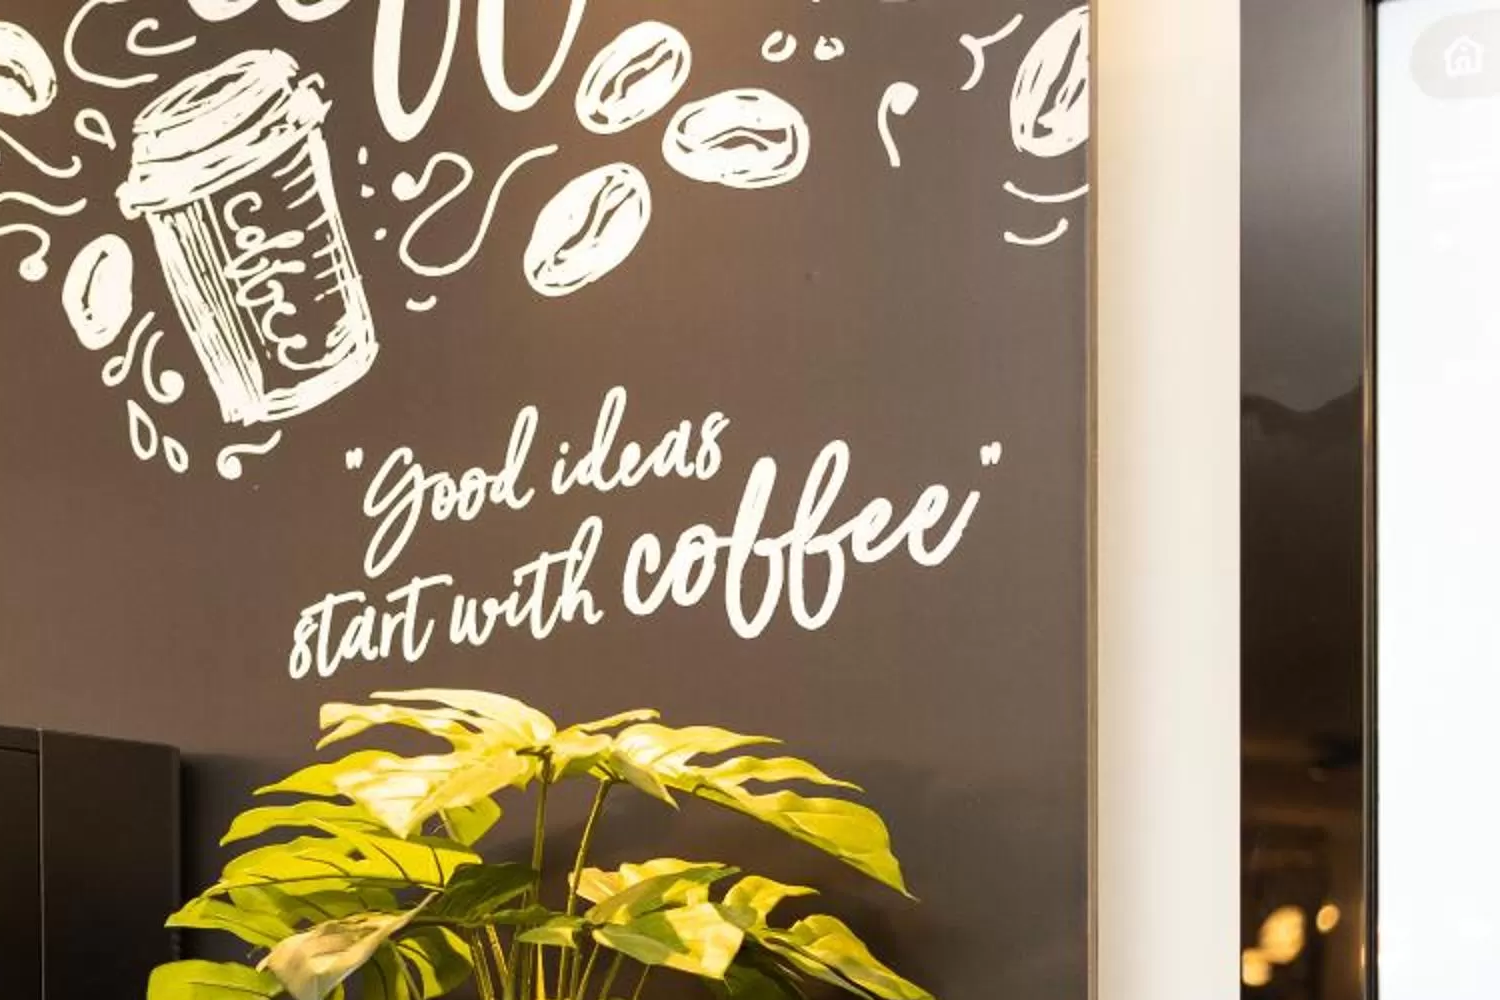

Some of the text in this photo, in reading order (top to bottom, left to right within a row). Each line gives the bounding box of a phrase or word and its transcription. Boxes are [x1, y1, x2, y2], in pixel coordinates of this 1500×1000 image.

[550, 385, 731, 494] ideas
[288, 574, 453, 680] start
[449, 514, 604, 640] with
